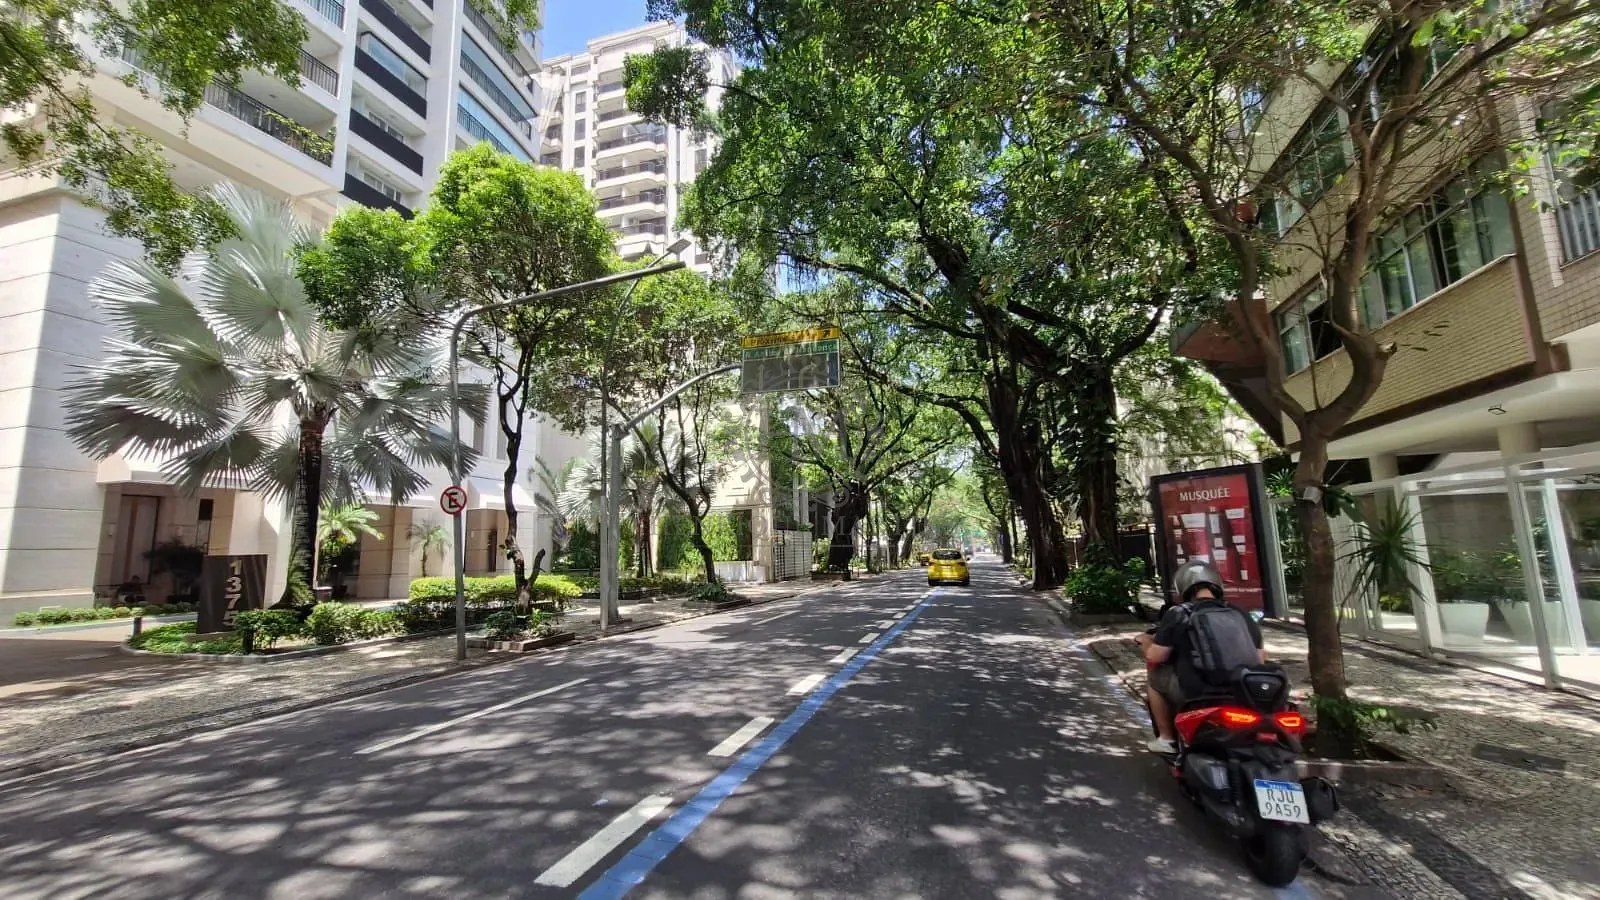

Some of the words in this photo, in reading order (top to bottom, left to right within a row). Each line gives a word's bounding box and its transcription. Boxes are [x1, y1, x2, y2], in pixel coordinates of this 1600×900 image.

[1179, 486, 1231, 502] MUSQUÉE
[222, 559, 242, 627] 1375
[1266, 788, 1295, 804] RJU
[1265, 801, 1301, 818] 9A59
